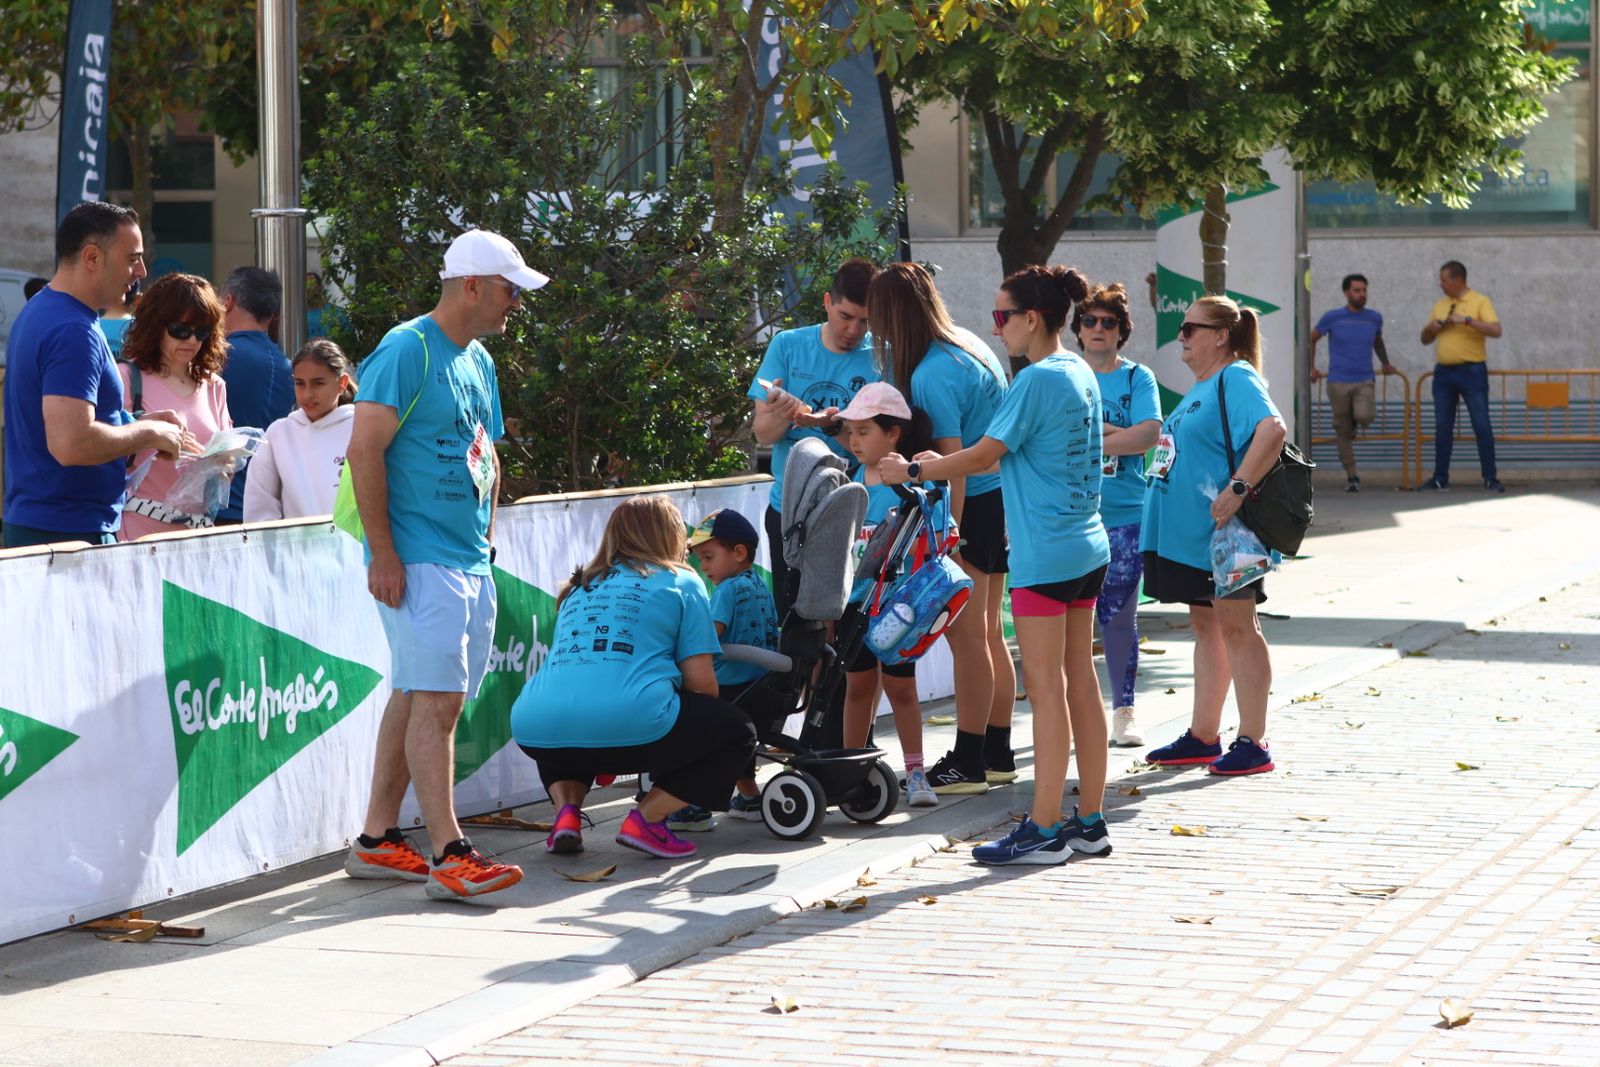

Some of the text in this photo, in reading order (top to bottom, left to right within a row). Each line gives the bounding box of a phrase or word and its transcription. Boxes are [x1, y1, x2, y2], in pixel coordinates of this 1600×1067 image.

[81, 32, 107, 202] nicaja
[486, 634, 525, 673] orte
[174, 656, 339, 741] El Corte Inglés
